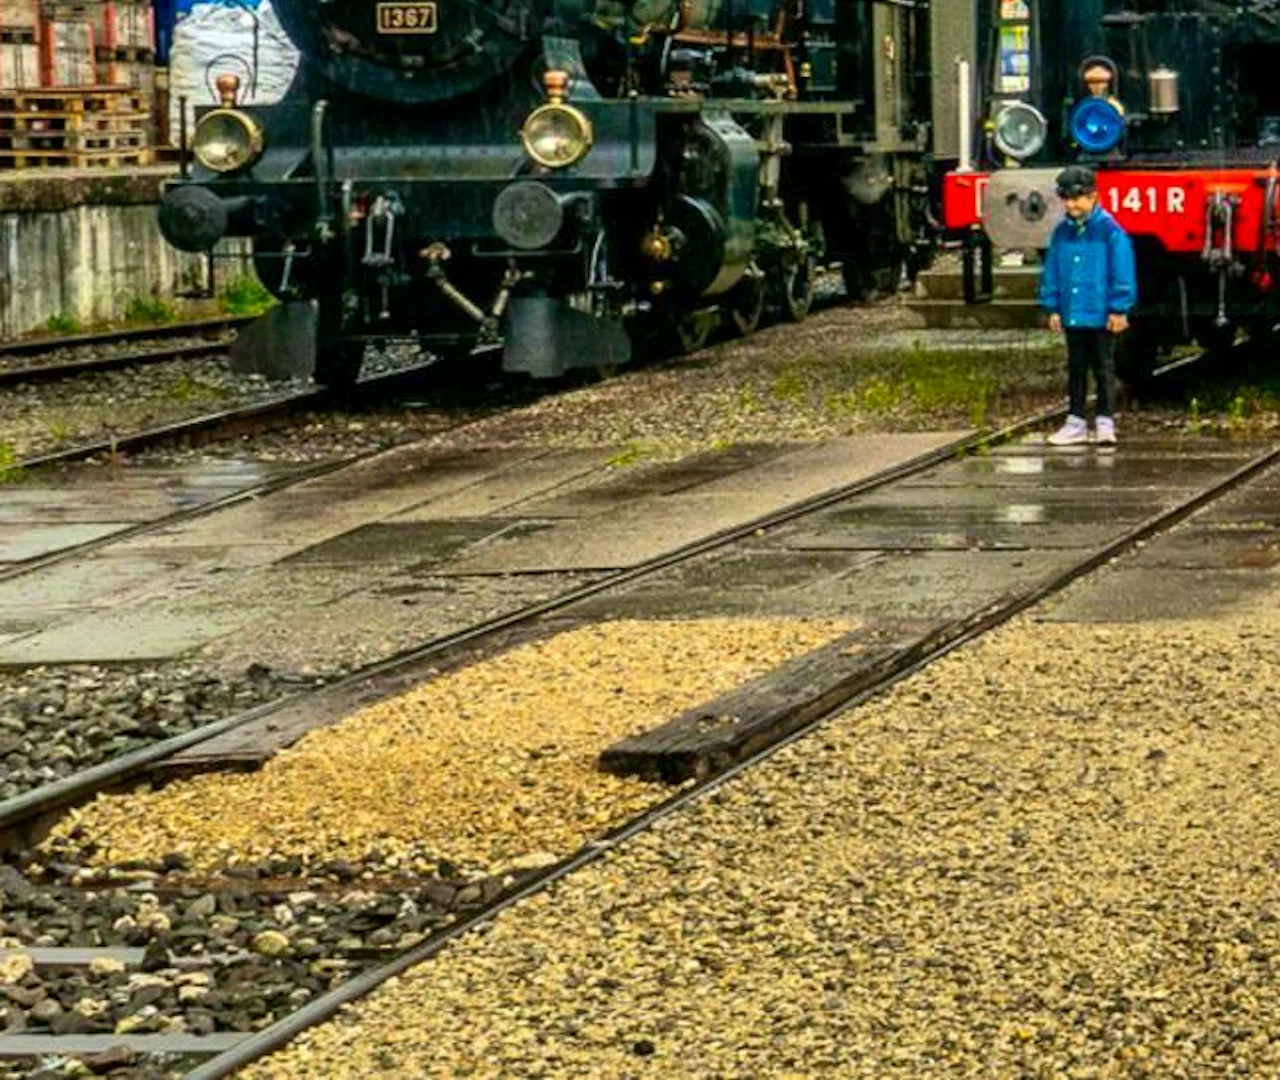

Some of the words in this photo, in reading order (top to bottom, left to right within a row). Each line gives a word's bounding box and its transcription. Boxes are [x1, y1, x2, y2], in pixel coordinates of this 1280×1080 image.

[383, 8, 431, 27] 1367
[1107, 186, 1157, 213] 141
[1166, 186, 1185, 213] R
